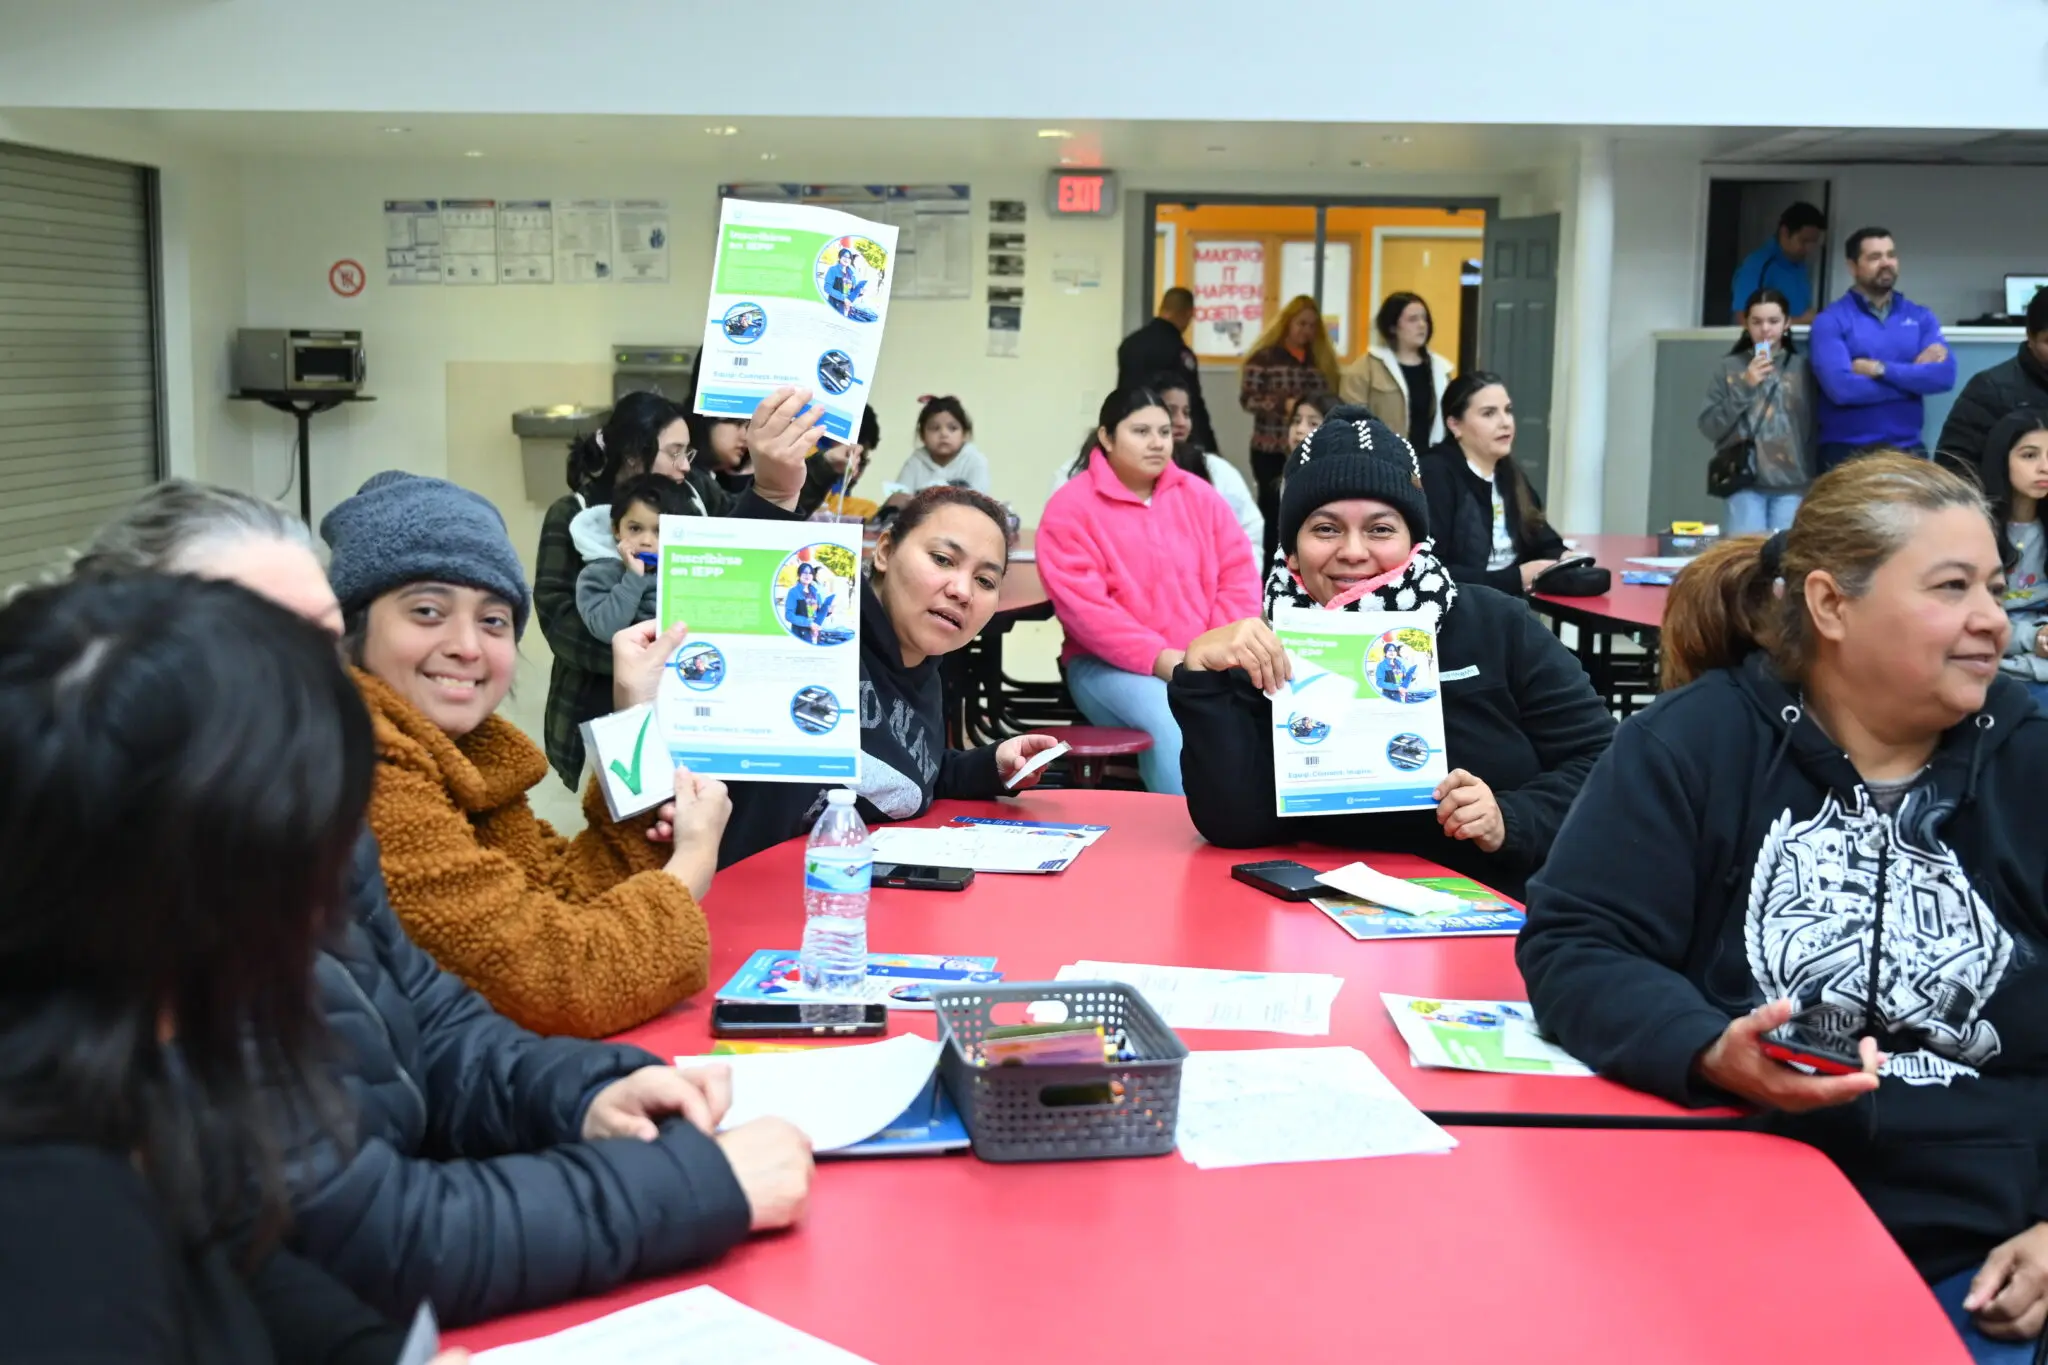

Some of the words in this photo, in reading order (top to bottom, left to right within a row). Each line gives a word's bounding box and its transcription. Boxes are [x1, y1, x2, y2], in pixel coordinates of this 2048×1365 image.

[1058, 175, 1104, 213] EXIT
[1194, 247, 1264, 262] MAKING
[1222, 266, 1238, 283] IT
[1194, 284, 1264, 299] HAPPEN
[671, 552, 743, 567] Inscribirse
[670, 567, 689, 577] en
[691, 566, 725, 579] IEPP
